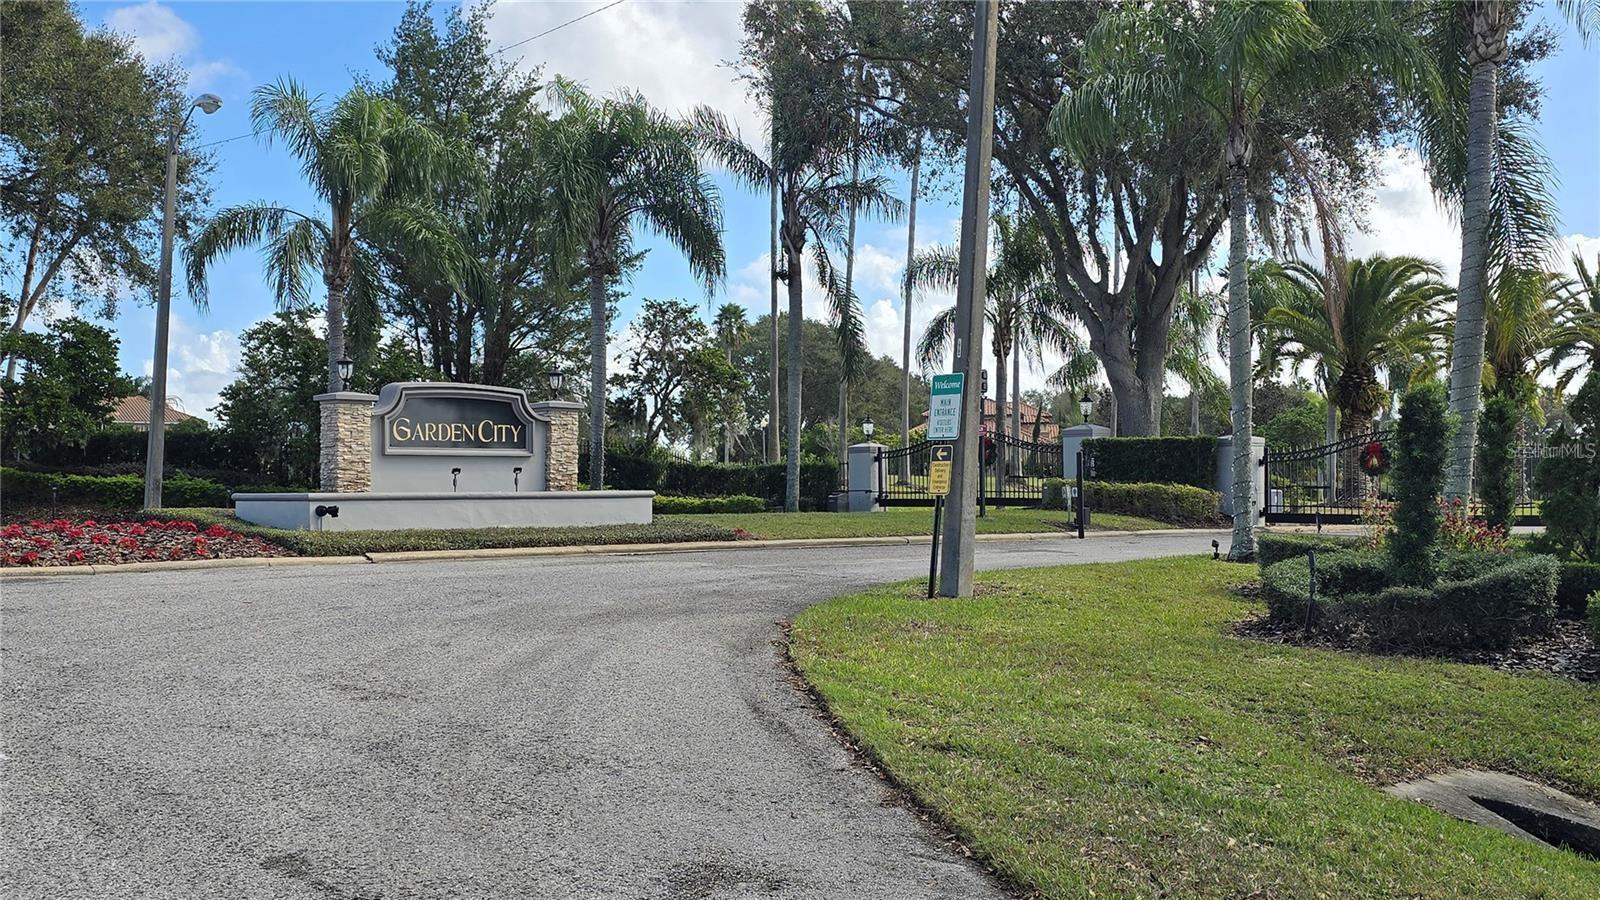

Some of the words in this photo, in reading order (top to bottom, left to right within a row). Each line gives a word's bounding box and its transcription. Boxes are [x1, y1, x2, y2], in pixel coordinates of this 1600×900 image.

[934, 380, 961, 390] Welcome
[934, 407, 956, 417] ENTRANCE
[392, 417, 475, 441] GARDEN
[478, 420, 522, 442] CITY
